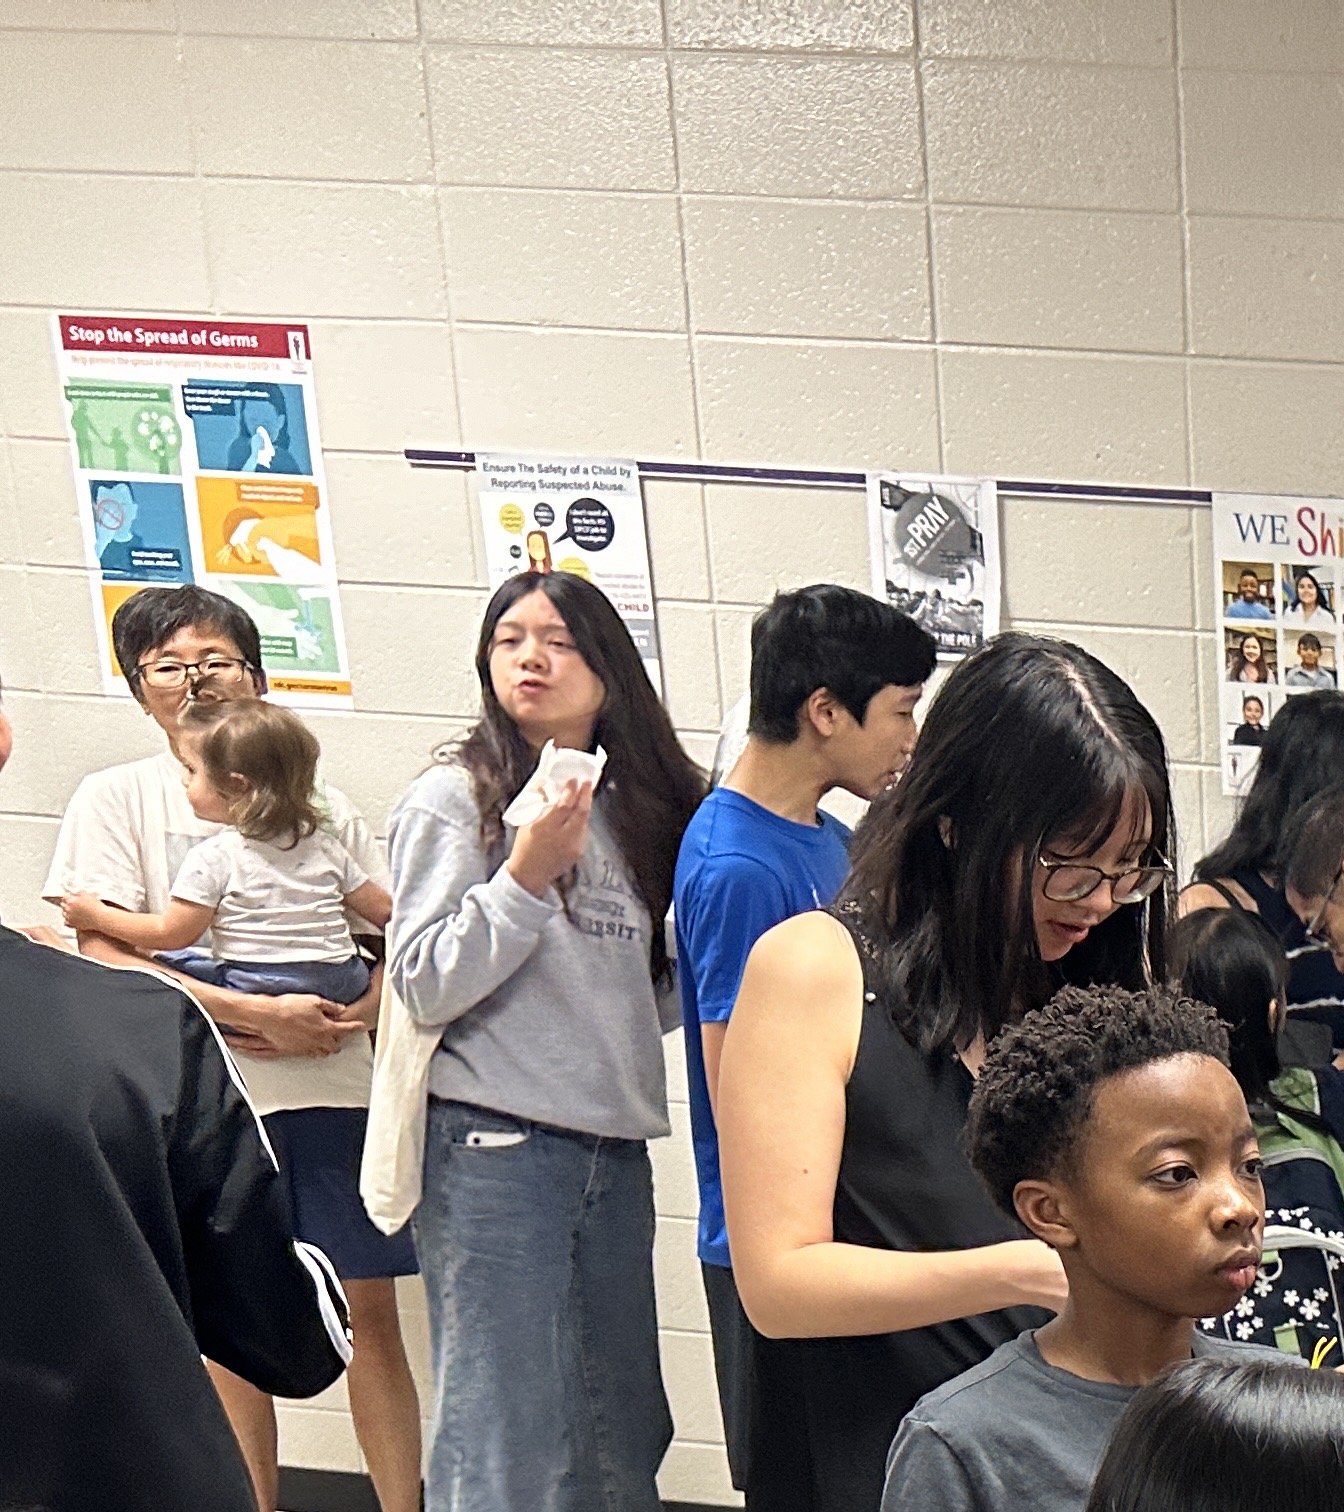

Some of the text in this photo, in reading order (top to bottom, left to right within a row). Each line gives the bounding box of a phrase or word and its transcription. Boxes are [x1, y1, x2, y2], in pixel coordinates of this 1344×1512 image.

[69, 326, 258, 348] Stop the Spread of Germs
[483, 462, 631, 478] Ensure The Safety of a Child by
[491, 478, 536, 491] Reporting
[538, 479, 590, 491] Suspected
[907, 496, 950, 548] PRAY
[1233, 512, 1290, 546] WE
